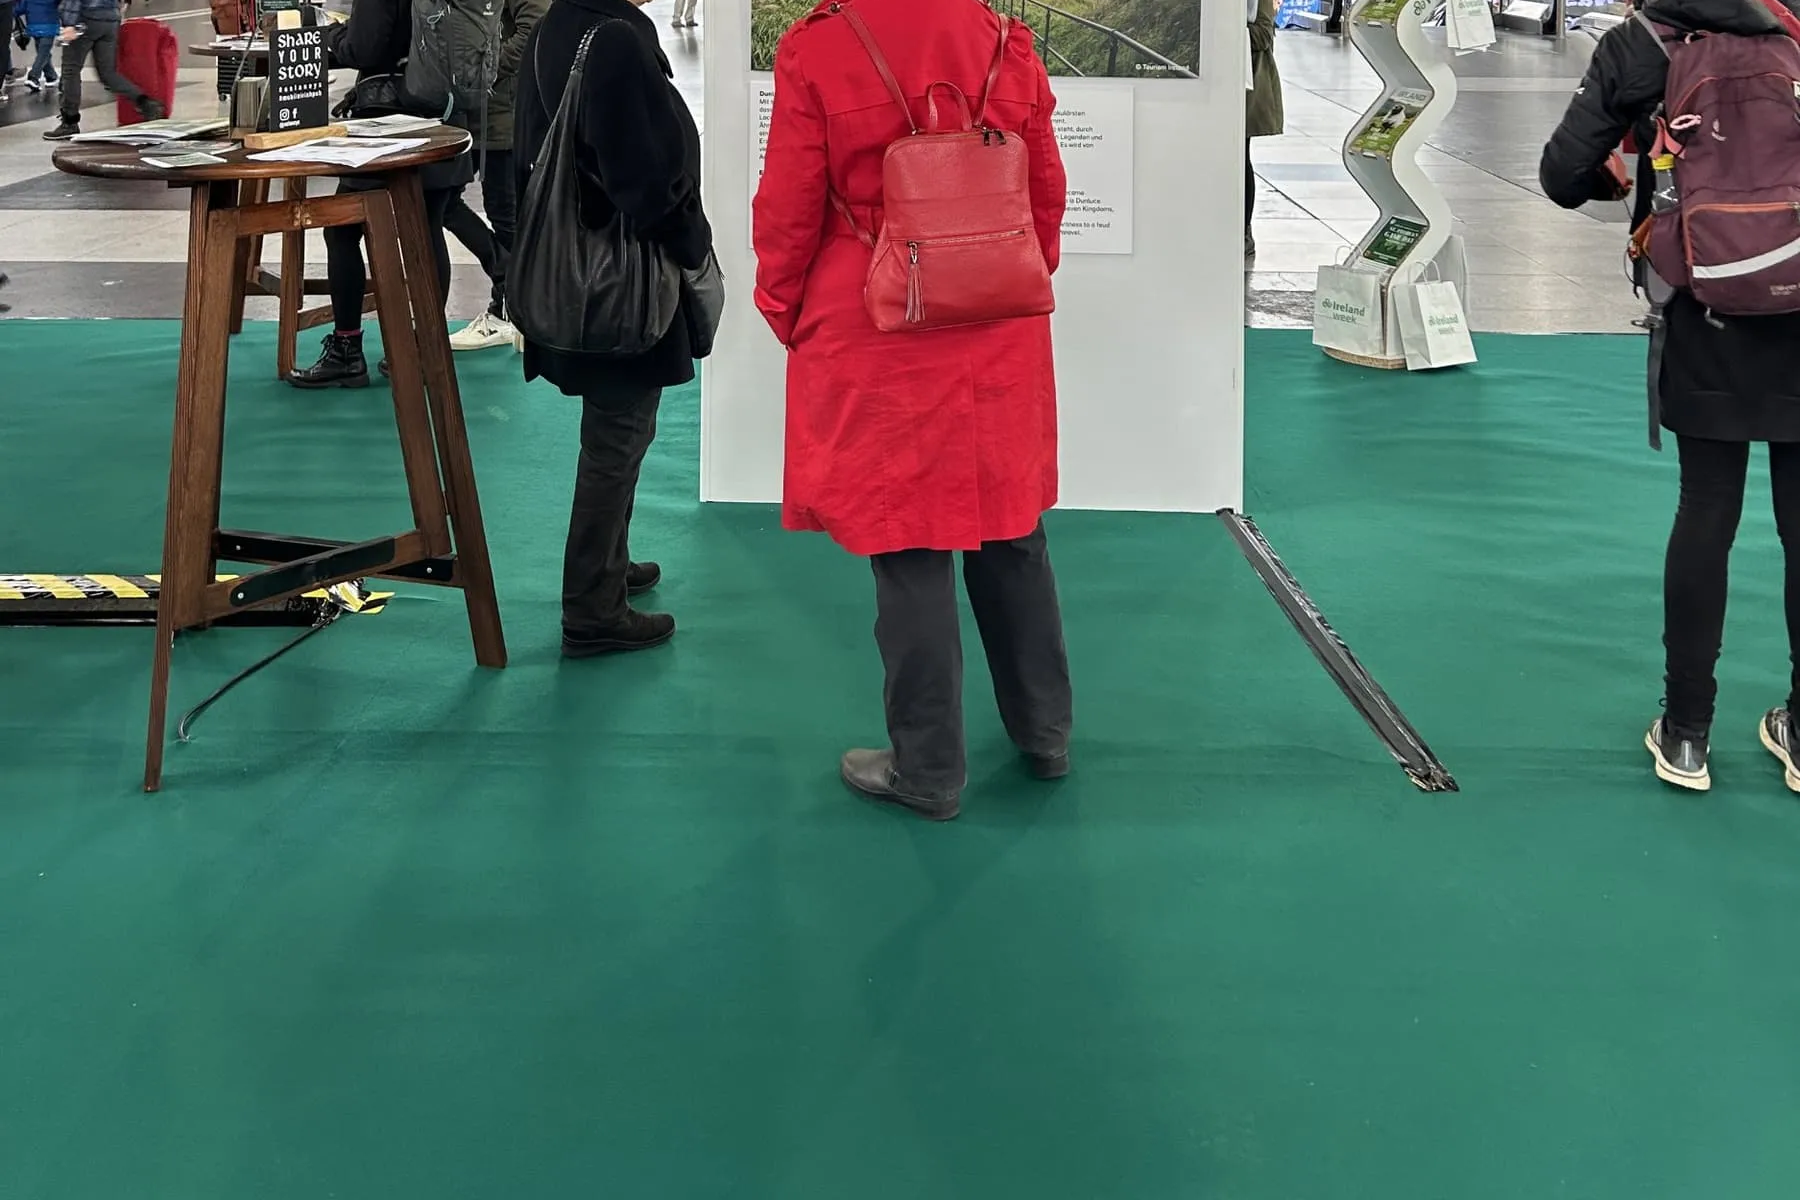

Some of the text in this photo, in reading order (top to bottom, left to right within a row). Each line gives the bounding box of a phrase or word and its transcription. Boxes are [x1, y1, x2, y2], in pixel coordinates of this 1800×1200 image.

[278, 46, 321, 64] YOUR
[1333, 300, 1366, 317] Ireland
[1333, 313, 1357, 325] week
